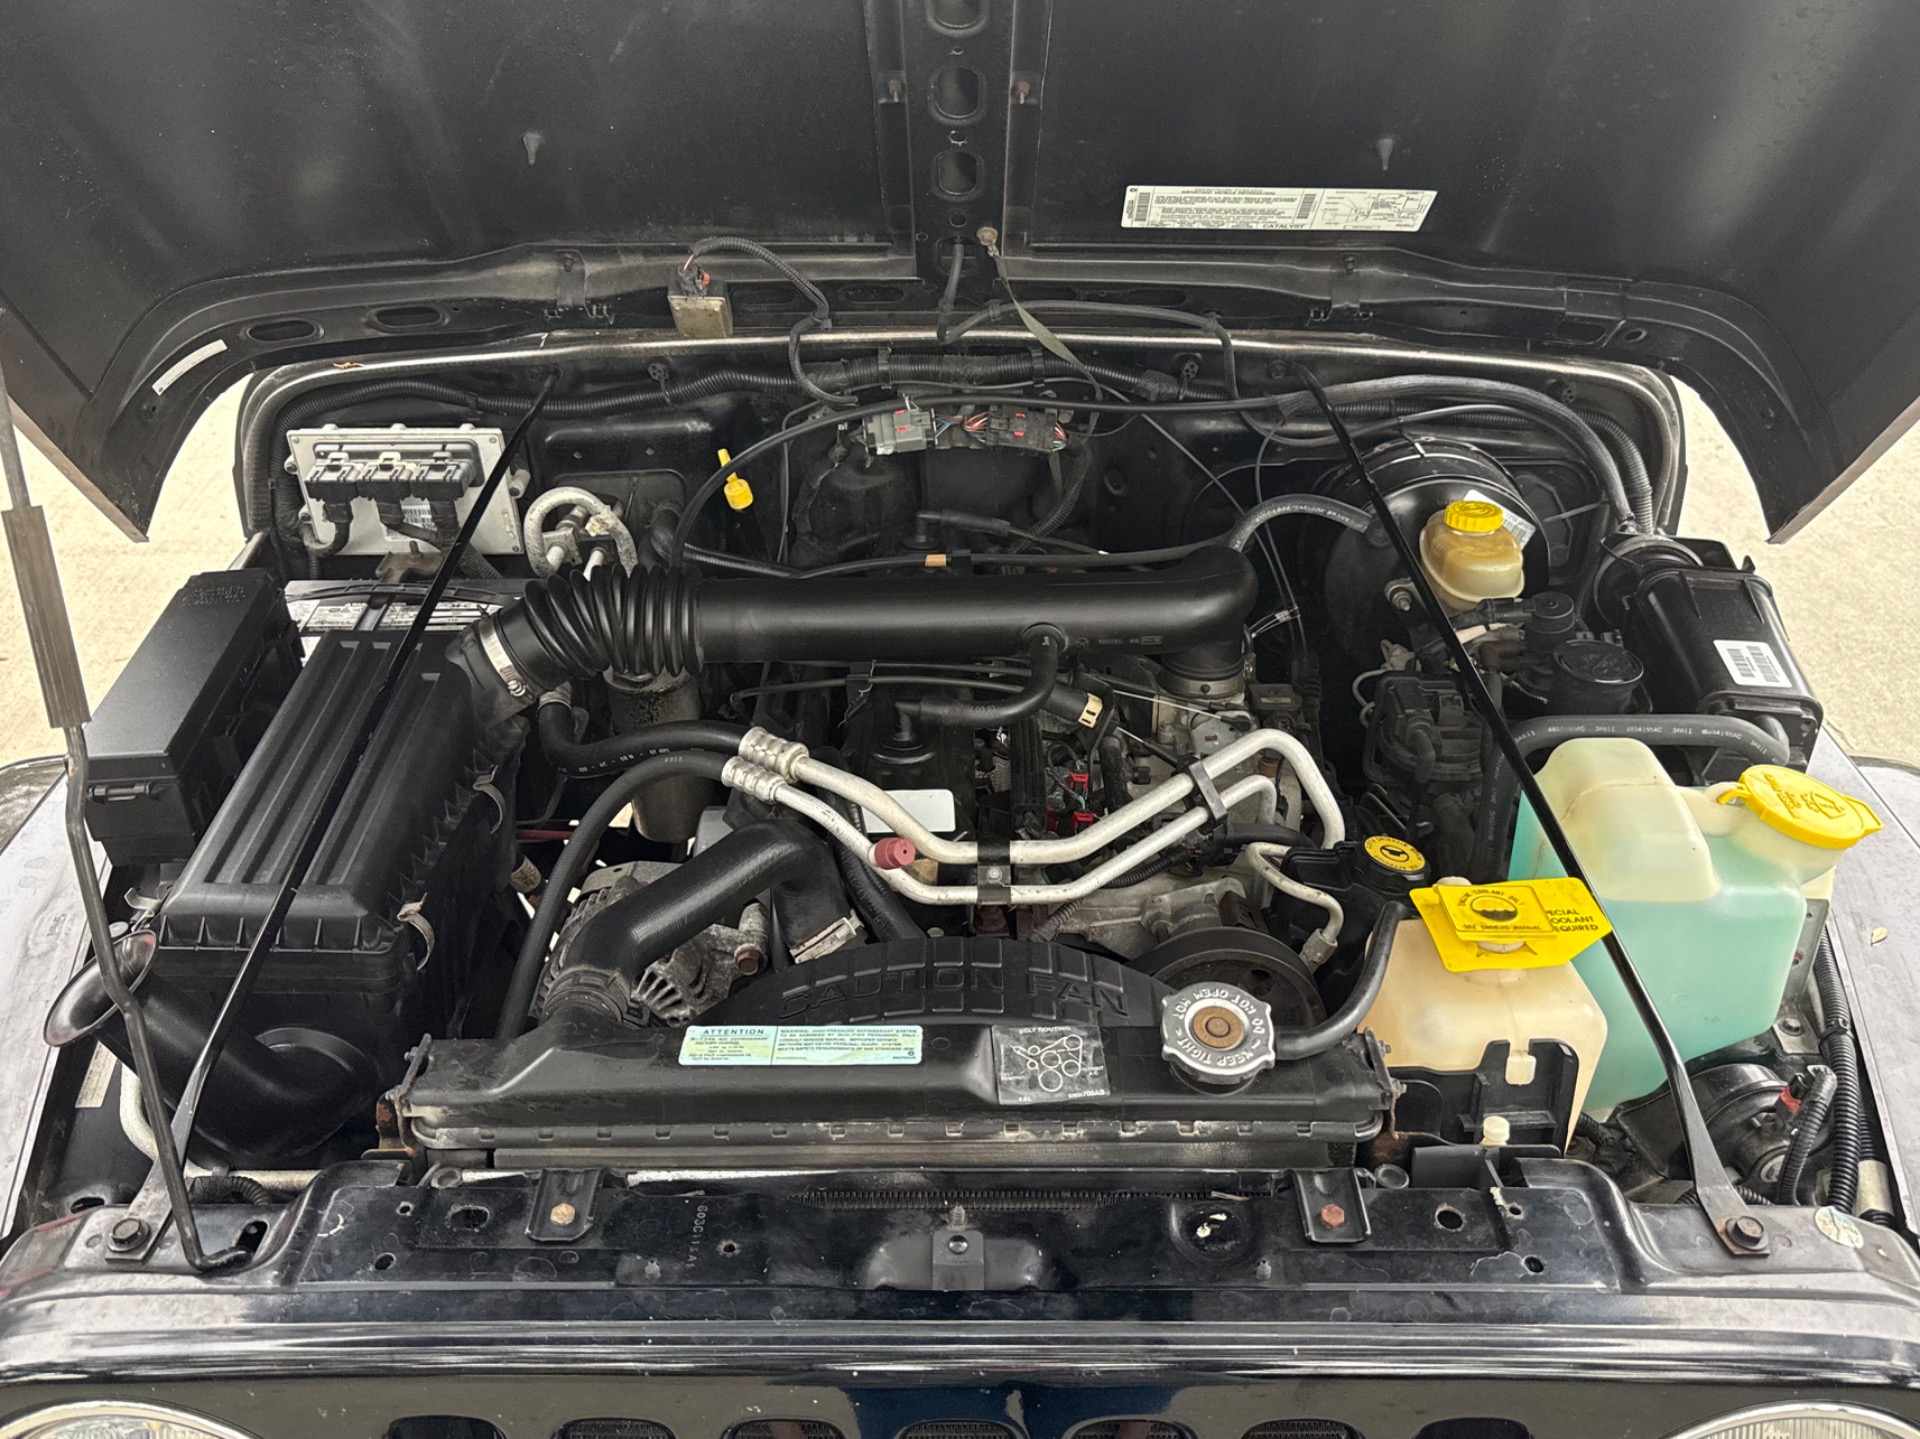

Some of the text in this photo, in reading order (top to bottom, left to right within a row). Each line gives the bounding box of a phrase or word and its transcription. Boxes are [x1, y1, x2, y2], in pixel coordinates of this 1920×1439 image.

[1551, 916, 1594, 924] OOLANT
[1554, 924, 1599, 932] EQUIRED
[778, 968, 1129, 1019] CAUTION FAN
[1193, 989, 1229, 1000] OPEN
[1172, 998, 1192, 1020] HOT
[1231, 995, 1257, 1015] NOT
[1177, 1037, 1254, 1067] KEEP TIGHT
